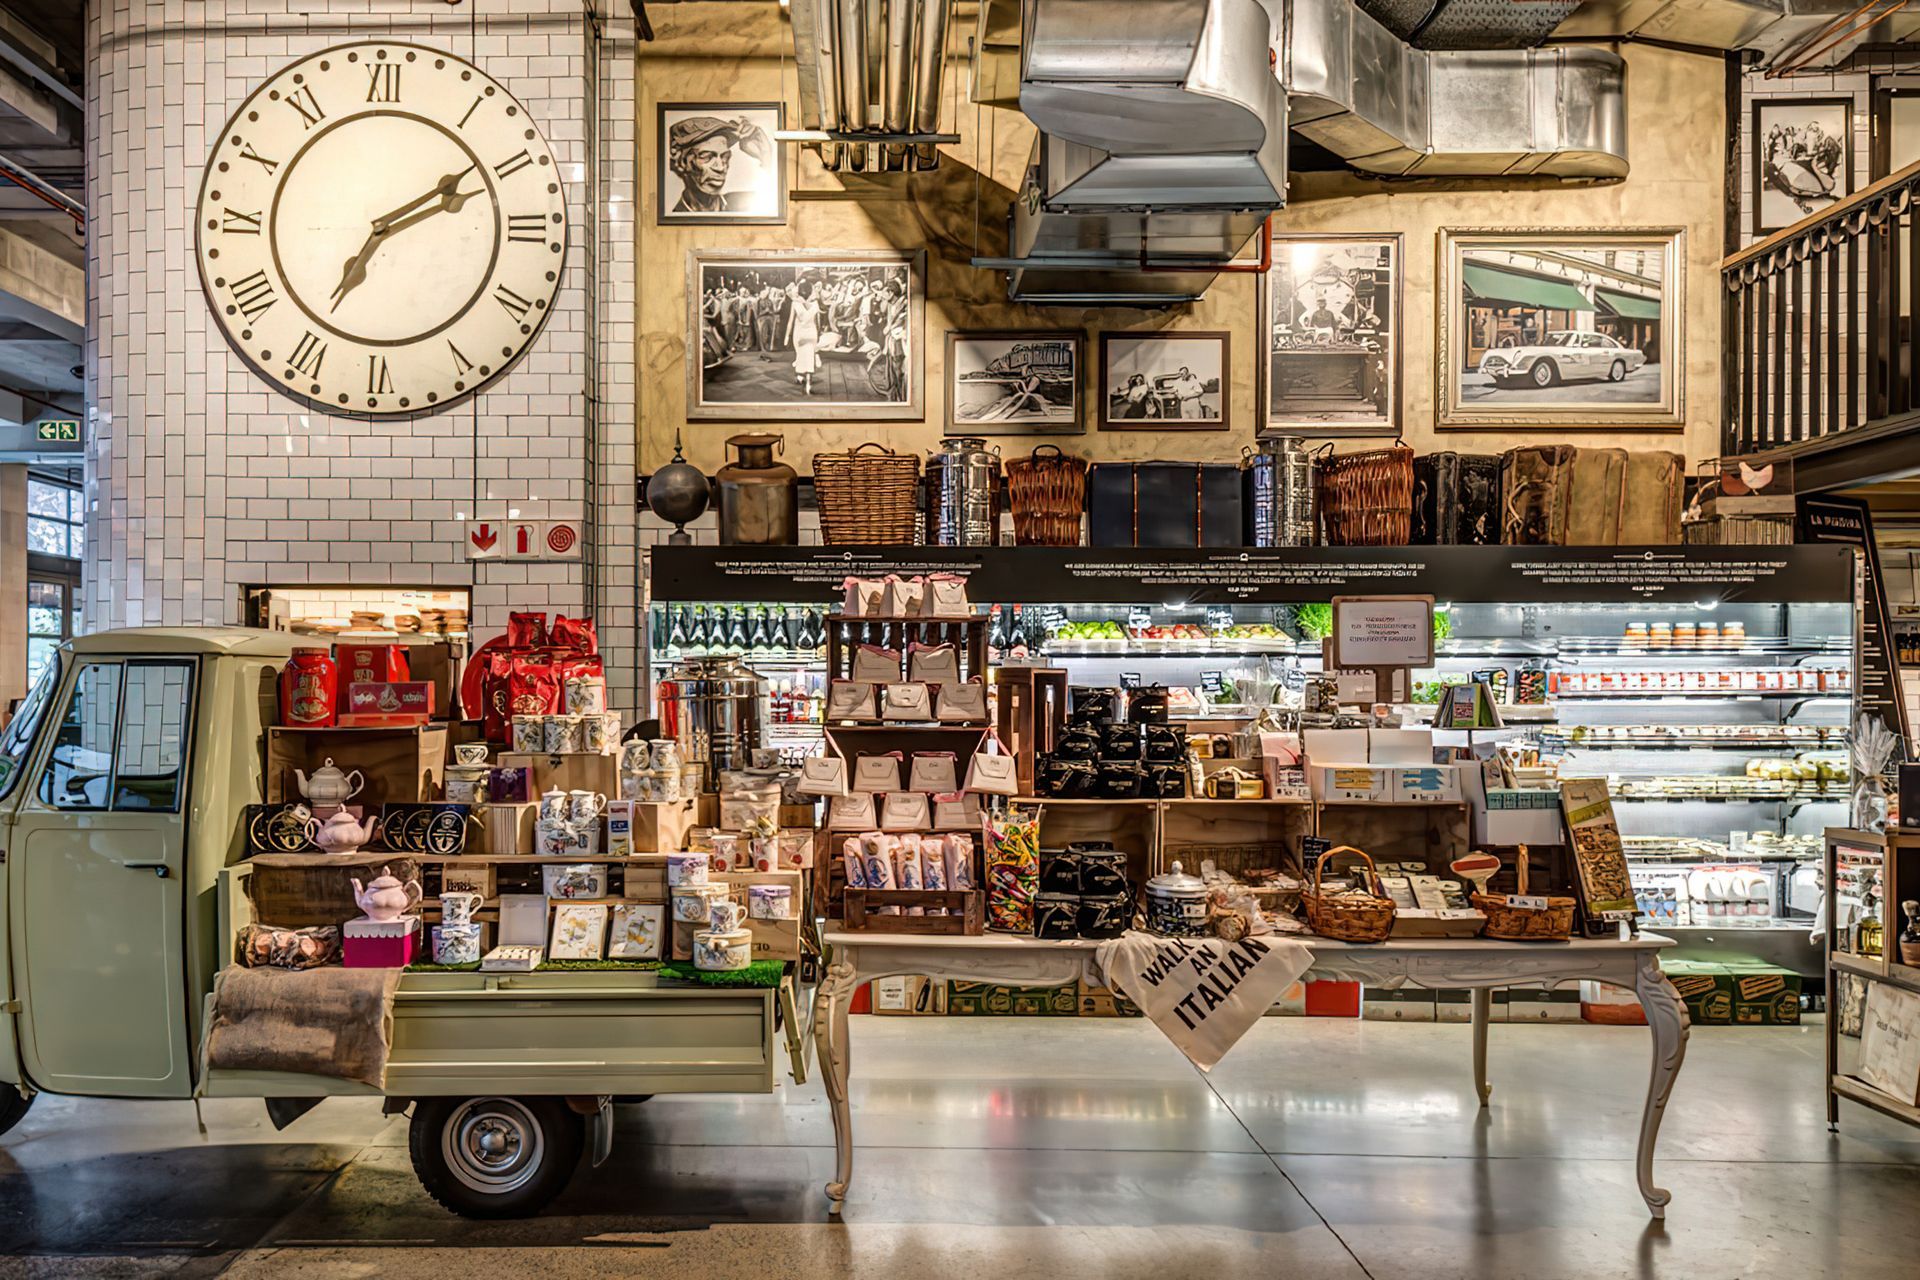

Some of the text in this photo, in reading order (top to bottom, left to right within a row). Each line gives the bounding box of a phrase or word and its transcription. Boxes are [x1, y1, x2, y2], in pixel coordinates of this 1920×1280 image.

[366, 64, 401, 102] XII
[285, 85, 327, 129] XI
[457, 96, 483, 128] I
[239, 142, 280, 176] X
[493, 149, 534, 180] II
[222, 207, 263, 236] IX
[508, 214, 546, 243] III
[230, 269, 279, 325] VIII
[493, 284, 532, 323] IV
[286, 330, 328, 379] VII
[447, 338, 475, 376] V
[366, 355, 395, 394] VI
[1141, 938, 1194, 987] WALK
[1189, 944, 1218, 976] AN
[1173, 938, 1270, 1030] ITALIAN
